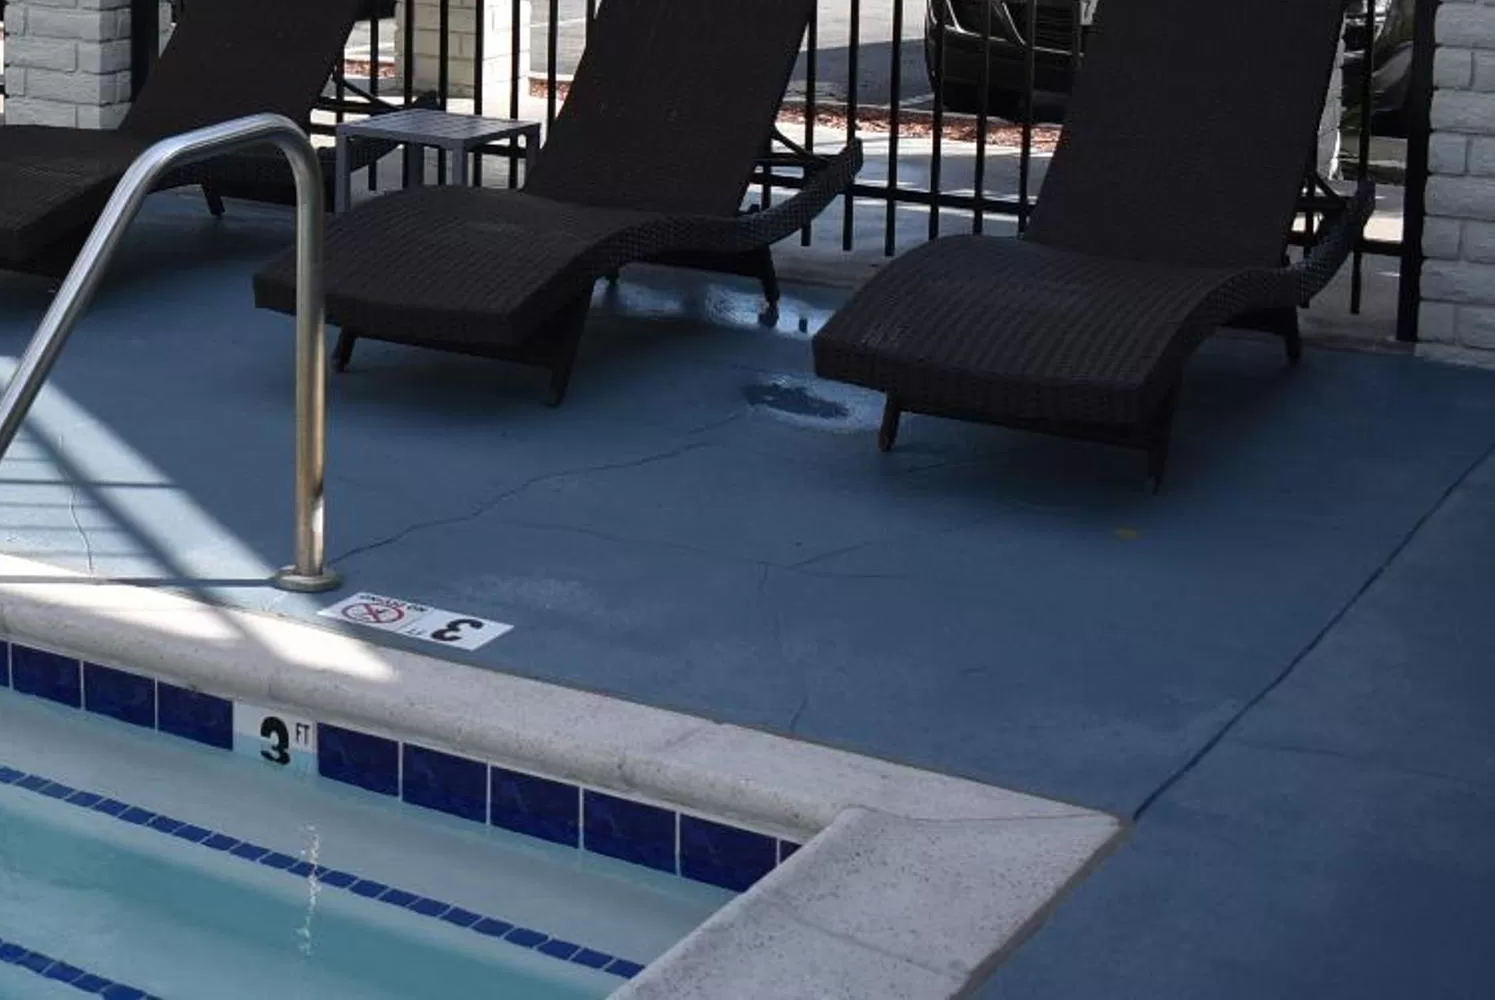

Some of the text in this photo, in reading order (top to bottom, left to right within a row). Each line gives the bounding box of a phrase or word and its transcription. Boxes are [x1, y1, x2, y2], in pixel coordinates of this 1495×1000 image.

[430, 618, 483, 642] 3
[260, 716, 310, 765] 3 FT
